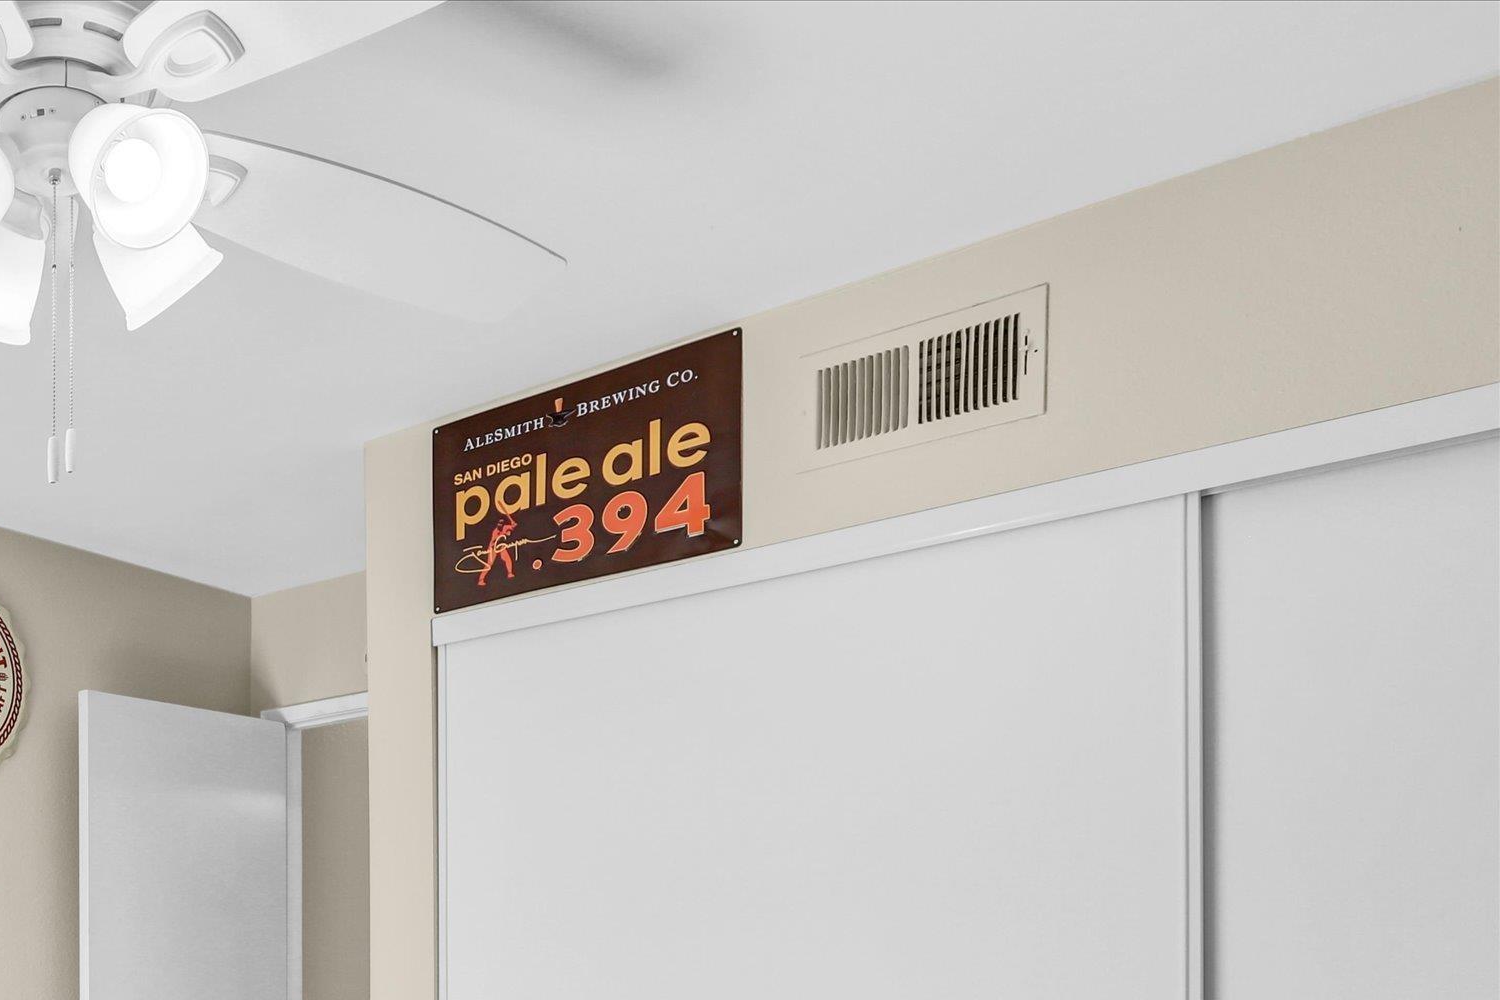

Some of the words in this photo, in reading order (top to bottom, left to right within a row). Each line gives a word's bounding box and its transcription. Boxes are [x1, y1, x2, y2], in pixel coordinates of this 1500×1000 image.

[576, 379, 660, 418] BREWING
[666, 368, 699, 388] CO.
[453, 467, 482, 486] SAN
[486, 453, 533, 475] DIEGO
[455, 452, 591, 541] pale
[602, 418, 711, 486] ale
[532, 471, 711, 571] .394
